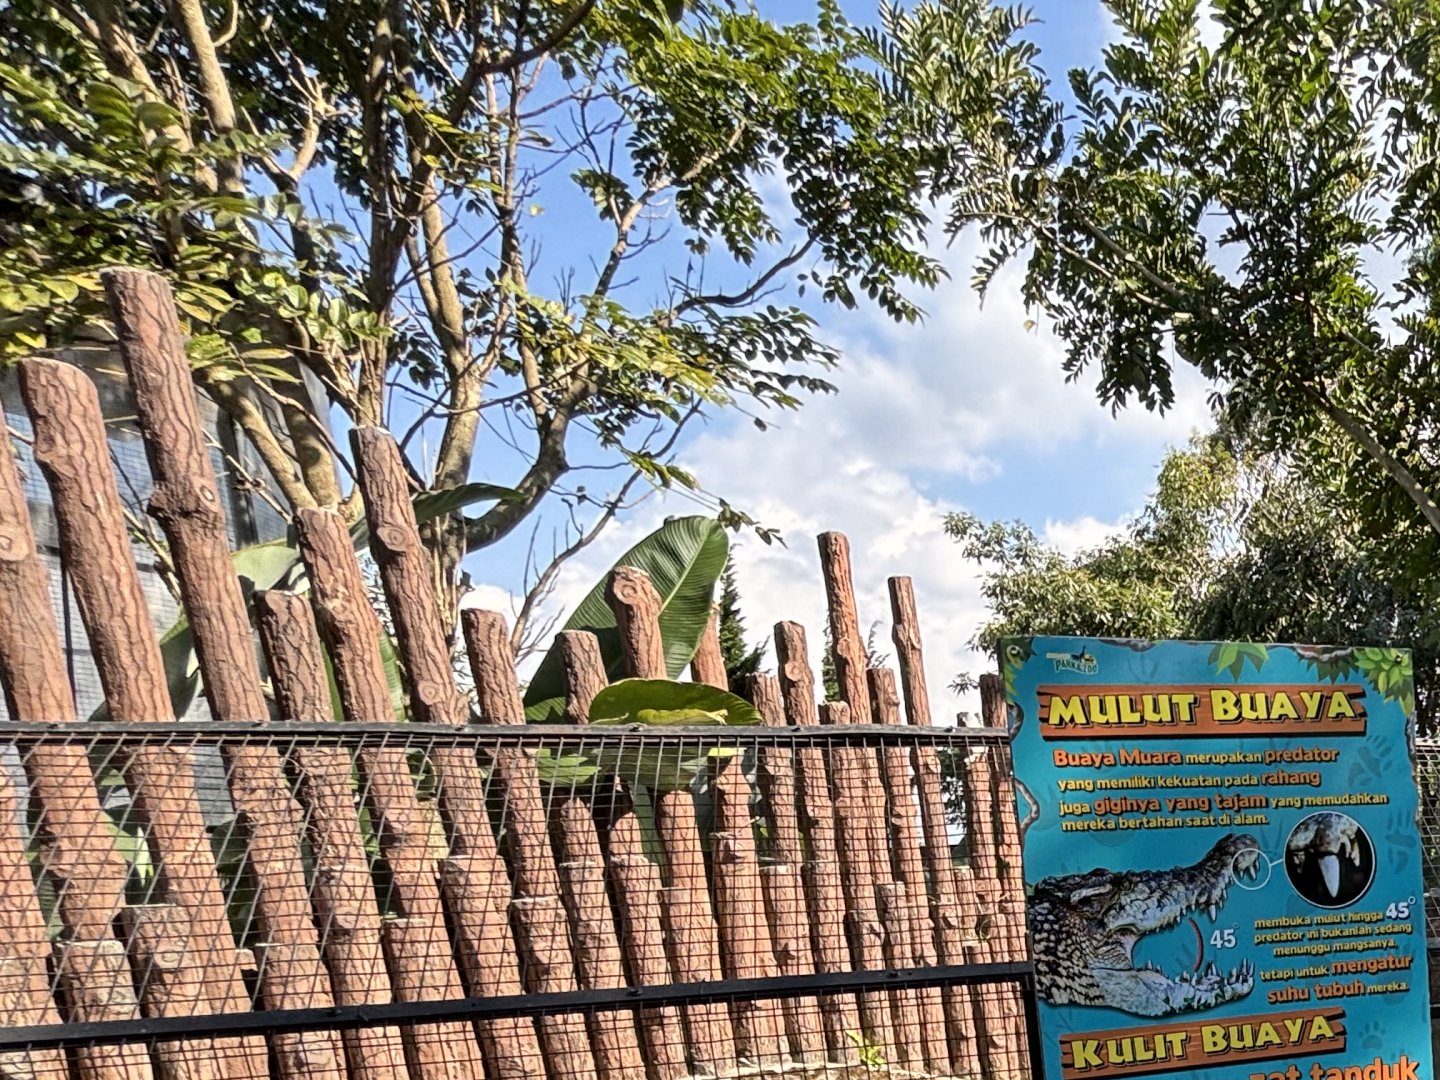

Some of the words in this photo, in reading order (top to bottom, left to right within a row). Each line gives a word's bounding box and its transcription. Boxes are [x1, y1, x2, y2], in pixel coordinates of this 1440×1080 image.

[1048, 693, 1196, 725] MULUT
[1209, 689, 1355, 721] BUAYA
[1053, 749, 1115, 767] Buaya
[1119, 748, 1181, 765] Muara
[1185, 752, 1261, 765] merupakan
[1265, 746, 1339, 764] predator
[1058, 779, 1093, 791] yang
[1097, 776, 1154, 789] memiliki
[1158, 774, 1221, 787] kekuatan
[1225, 774, 1258, 787] pada
[1262, 769, 1320, 786] rahang
[1060, 801, 1090, 816] juga
[1094, 796, 1160, 814] giginya
[1166, 797, 1209, 812] yang
[1215, 793, 1266, 811] tajam
[1270, 797, 1301, 808] yang
[1304, 793, 1387, 806] memudahkan
[1062, 819, 1115, 831] mereka
[1119, 816, 1182, 829] bertahan
[1186, 815, 1217, 826] saat
[1218, 814, 1230, 825] di
[1233, 813, 1269, 825] alam.
[1254, 916, 1310, 928] membuka
[1314, 913, 1345, 925] mulut
[1348, 911, 1383, 923] hingga
[1254, 929, 1303, 944] predator
[1307, 929, 1318, 940] ini
[1322, 925, 1371, 938] bukanlah
[1375, 922, 1411, 935] sedang
[1273, 944, 1330, 957] menunggu
[1260, 968, 1294, 982] tetapi
[1297, 965, 1328, 977] untuk
[1331, 955, 1412, 975] mengatur
[1268, 985, 1309, 1003] suhu
[1315, 981, 1364, 998] tubuh
[1071, 1031, 1188, 1069] KULIT
[1201, 1015, 1335, 1053] BUAYA
